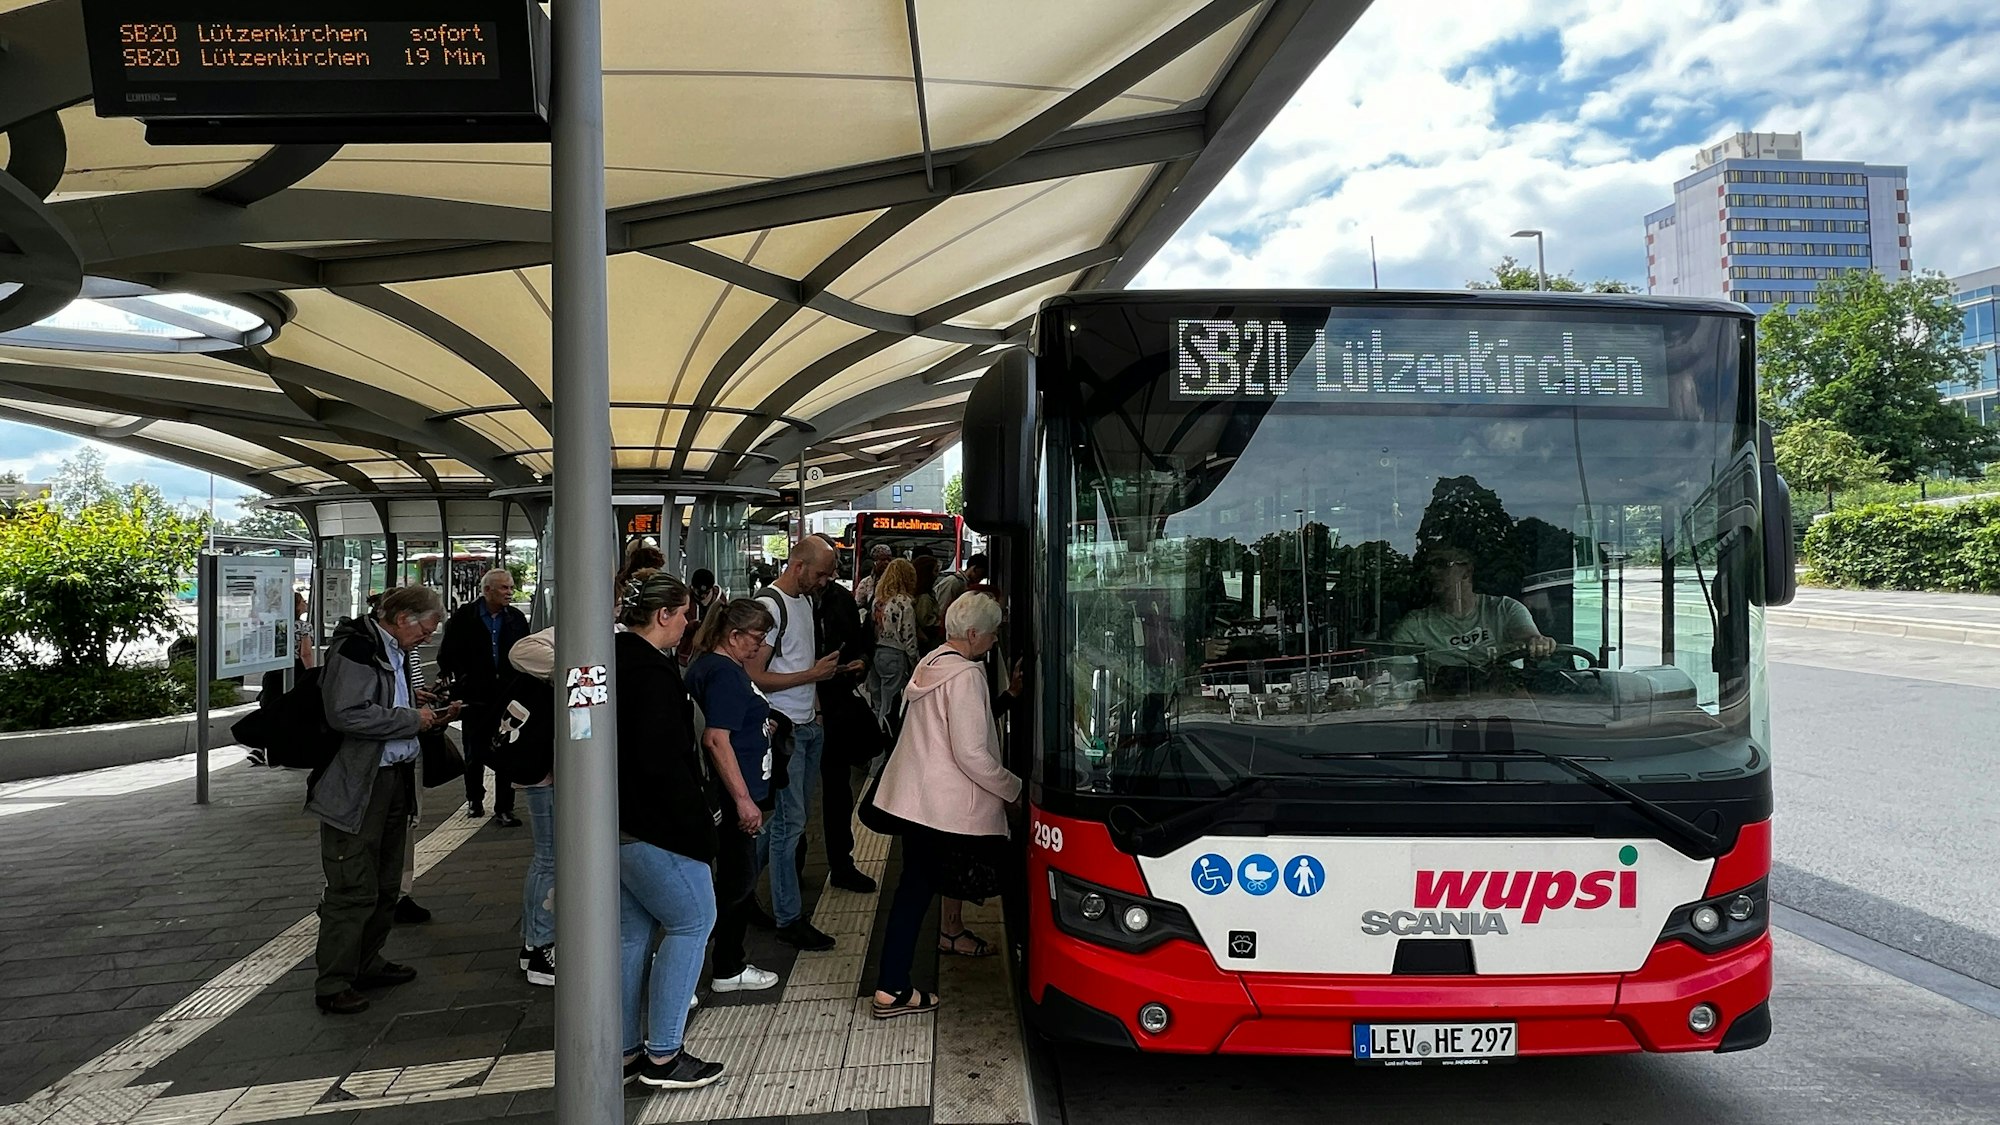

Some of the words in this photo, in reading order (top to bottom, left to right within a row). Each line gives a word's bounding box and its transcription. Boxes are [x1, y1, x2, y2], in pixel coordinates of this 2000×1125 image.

[120, 24, 177, 43] SB20
[198, 24, 368, 43] Lützenkirchen
[410, 23, 484, 46] sofort
[122, 48, 180, 67] SB20
[201, 48, 370, 67] Lützenkirchen
[404, 47, 430, 66] 19
[443, 47, 486, 66] Min
[1178, 319, 1288, 395] SB20
[1315, 329, 1644, 395] Lützenkirchen
[811, 469, 819, 481] 8
[1450, 629, 1490, 646] COPE
[1034, 820, 1063, 853] 299
[1413, 844, 1639, 925] wupsi
[1361, 909, 1509, 936] SCANIA
[1359, 1044, 1367, 1053] D
[1371, 1028, 1416, 1054] LEV
[1435, 1028, 1464, 1053] HE
[1471, 1027, 1513, 1053] 297
